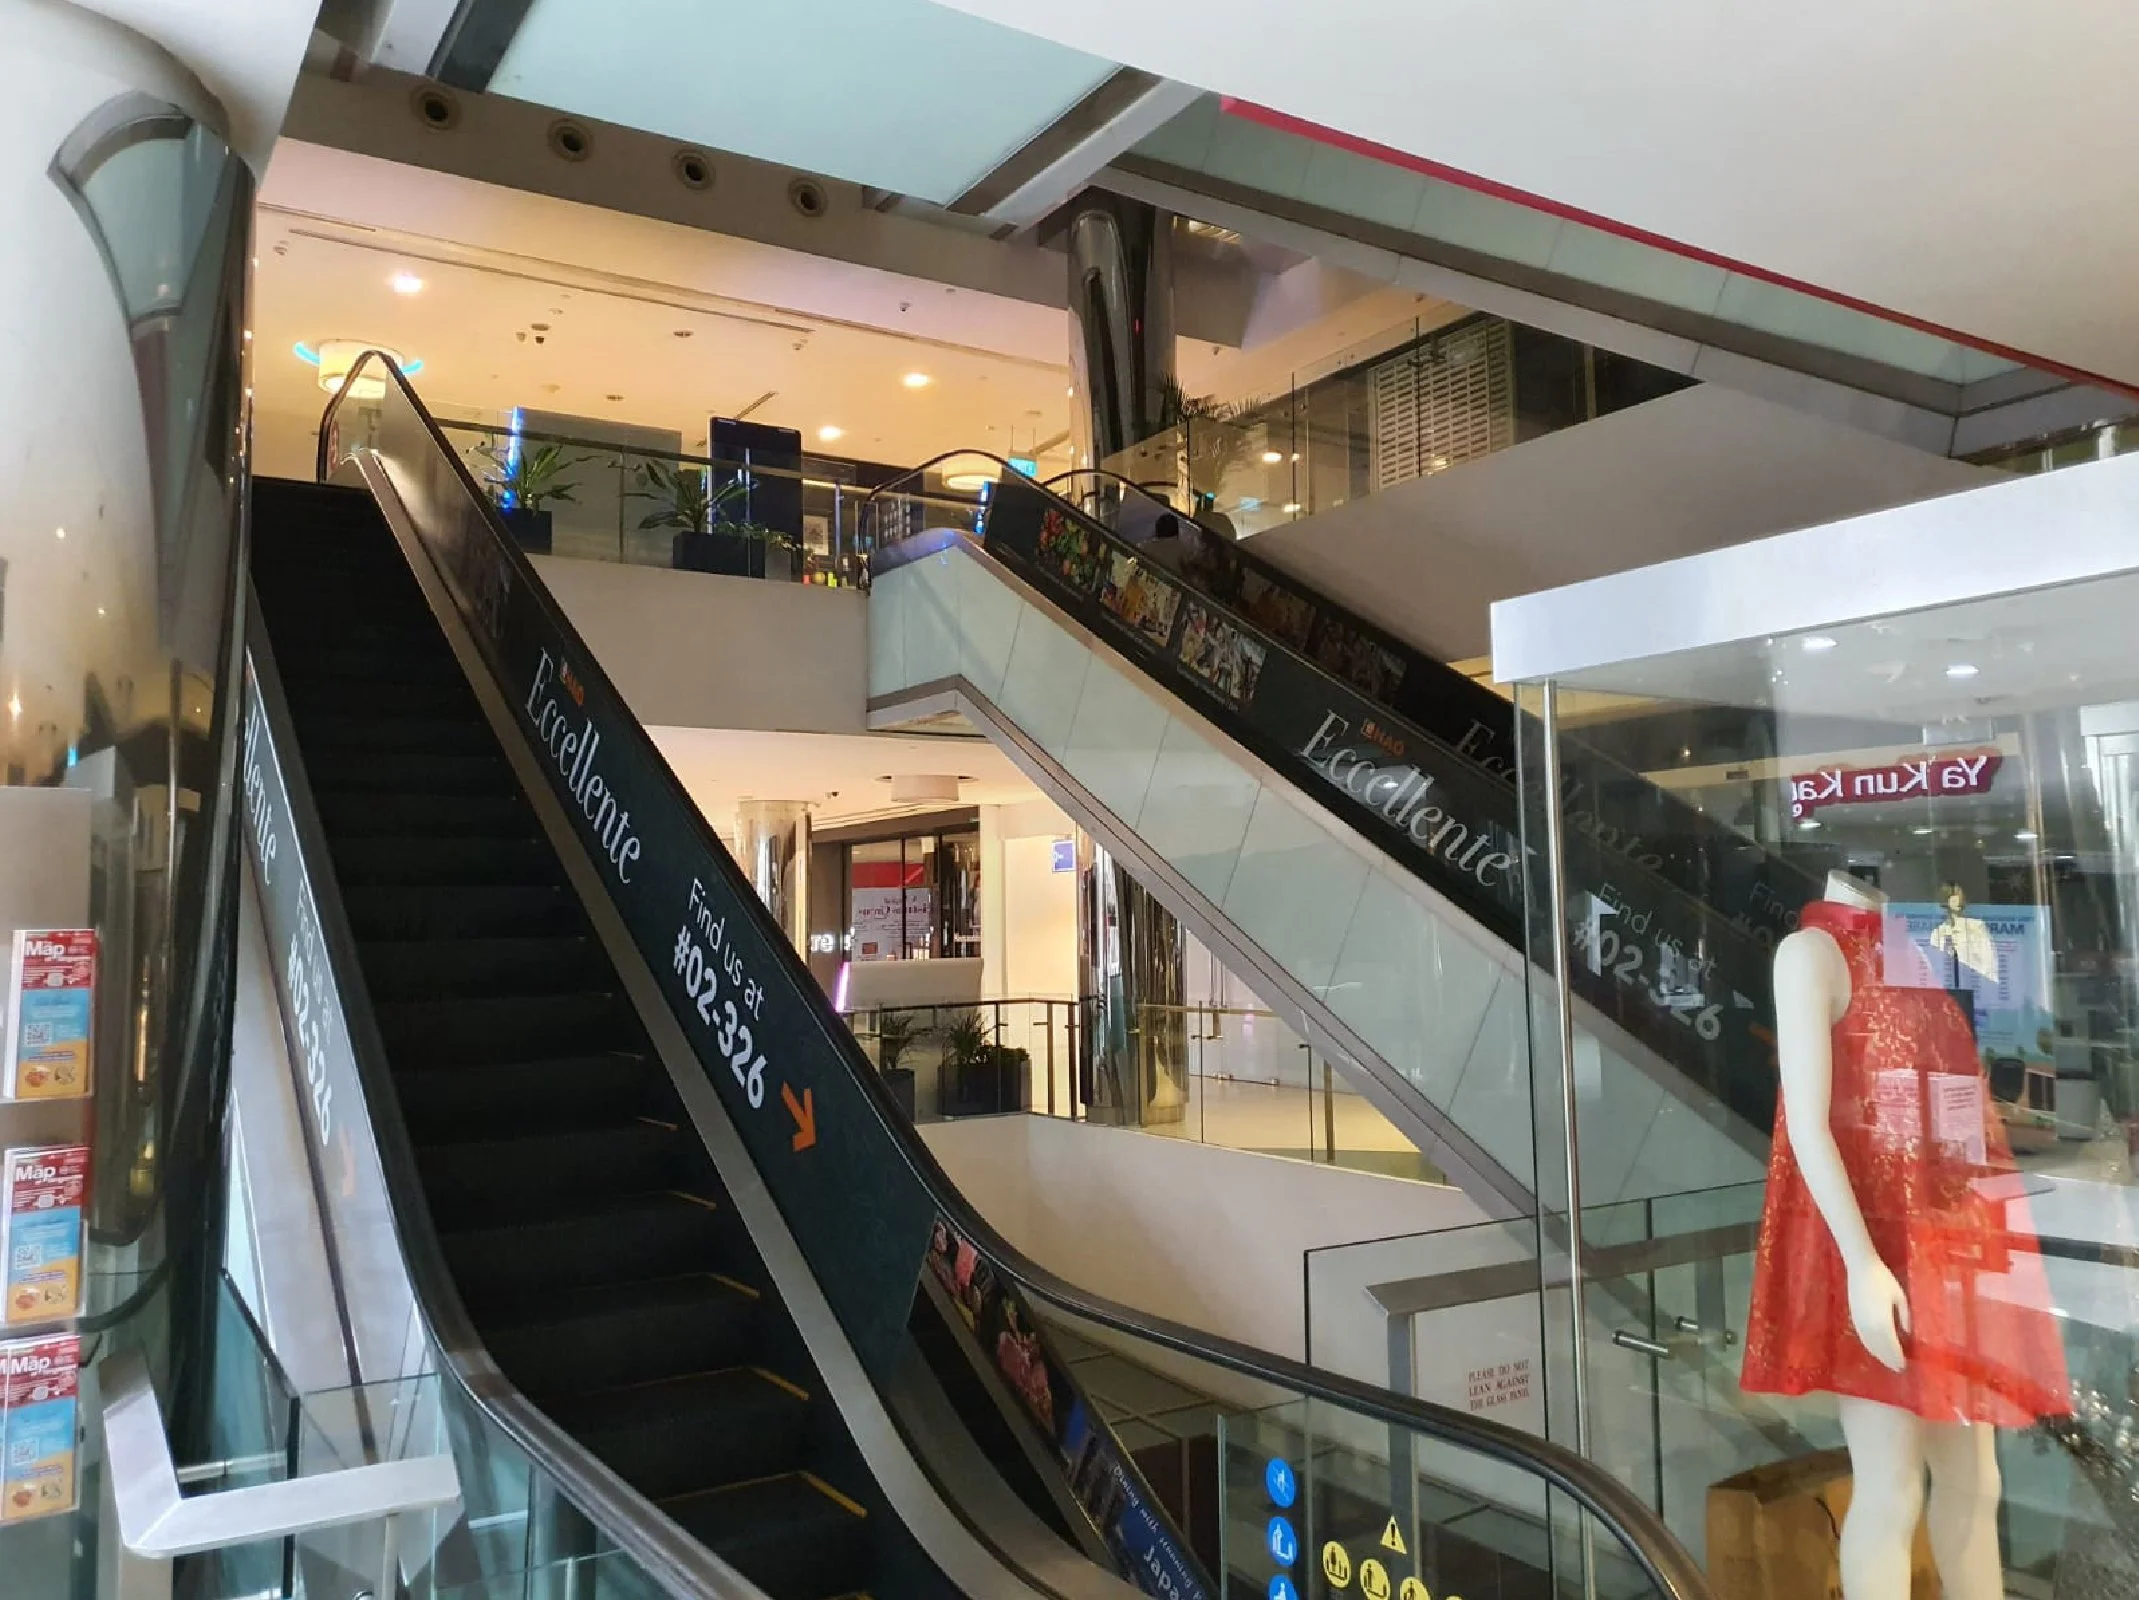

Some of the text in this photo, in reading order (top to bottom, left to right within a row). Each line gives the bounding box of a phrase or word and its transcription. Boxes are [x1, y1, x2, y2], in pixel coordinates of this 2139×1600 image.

[244, 704, 277, 886] llente
[525, 647, 642, 885] Eccellente
[1300, 709, 1512, 887] Eccellente
[25, 940, 65, 959] Map
[674, 925, 766, 1109] #02-326
[689, 877, 765, 1021] Find us at
[16, 1165, 56, 1182] Map
[11, 1356, 50, 1374] Map
